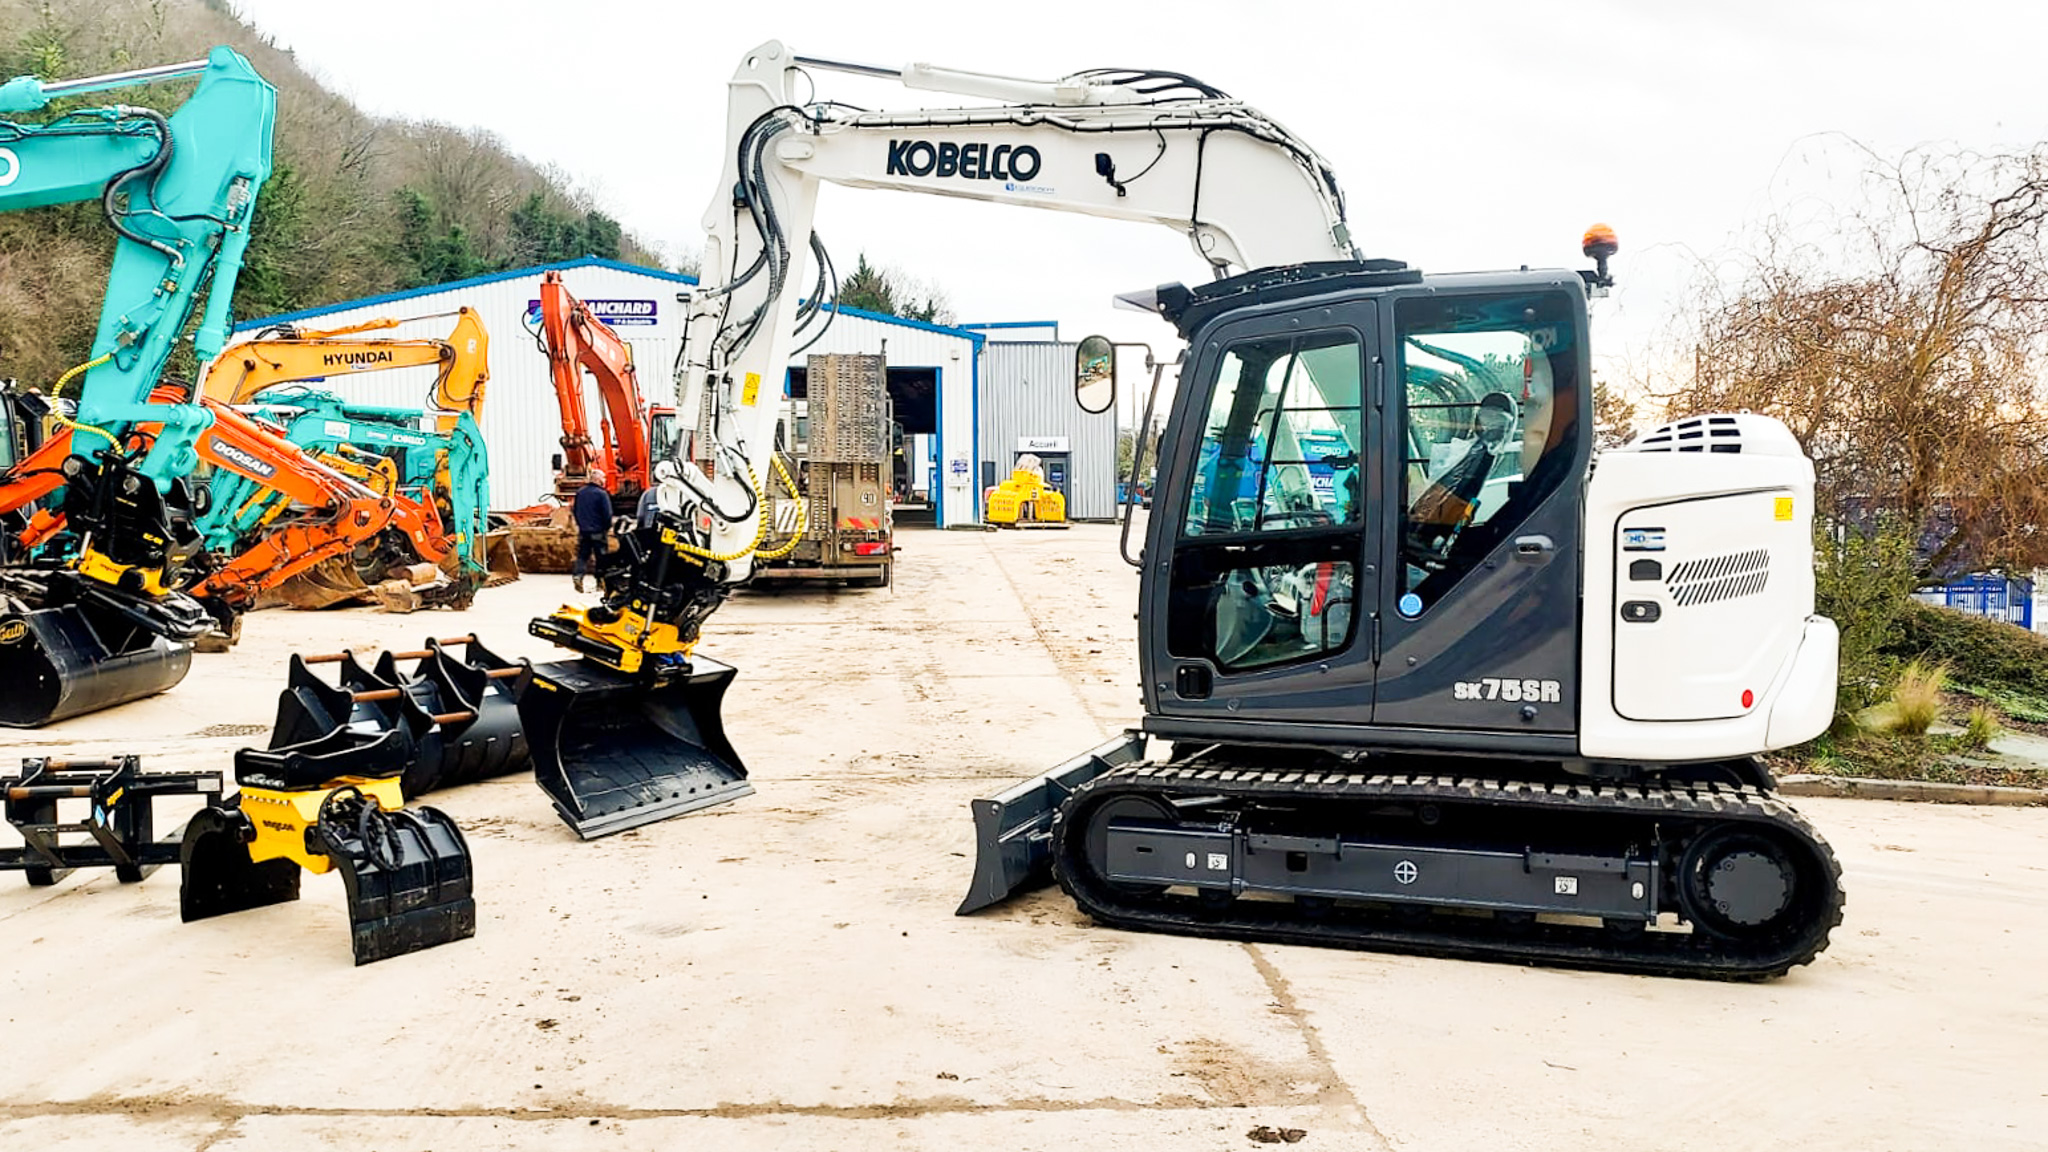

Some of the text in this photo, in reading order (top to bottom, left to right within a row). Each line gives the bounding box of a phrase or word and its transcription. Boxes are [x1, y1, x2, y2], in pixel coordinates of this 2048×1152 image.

[886, 139, 1042, 182] KOBELCO
[323, 350, 393, 366] HYUNDAI
[213, 441, 274, 476] DOOSAN
[1454, 678, 1561, 703] SK75SR
